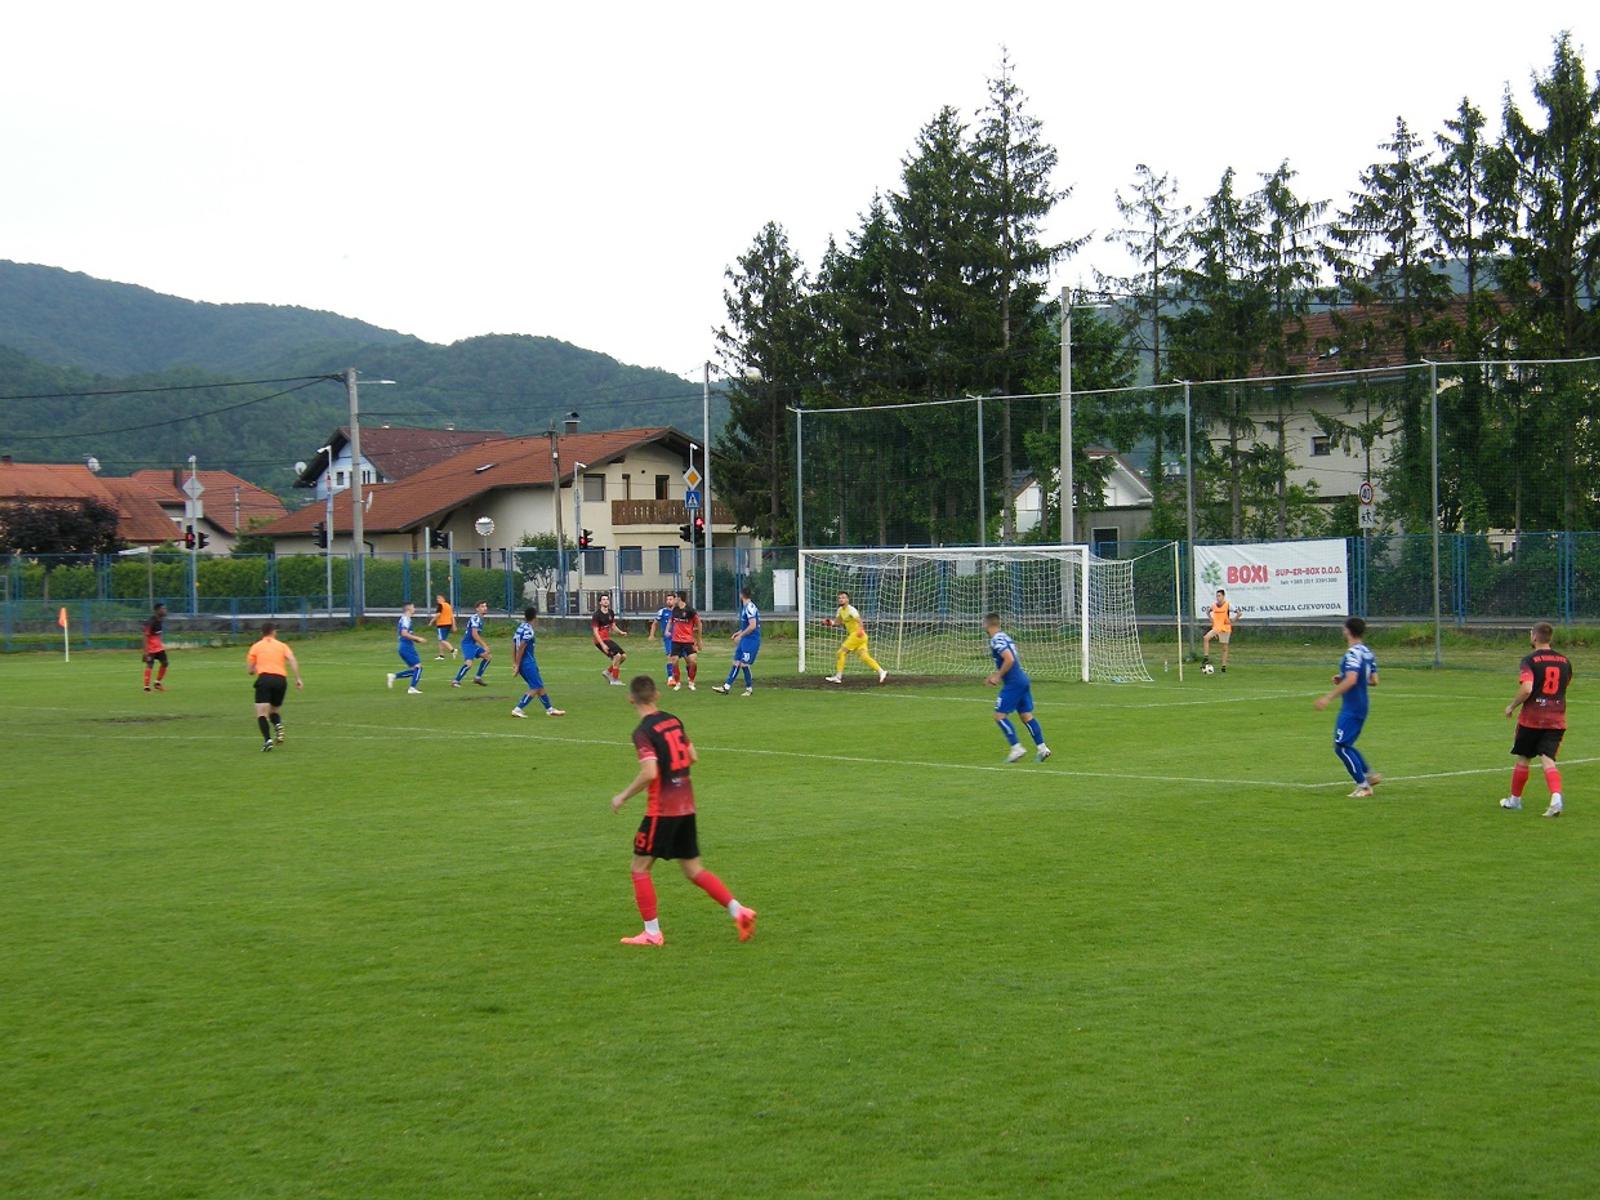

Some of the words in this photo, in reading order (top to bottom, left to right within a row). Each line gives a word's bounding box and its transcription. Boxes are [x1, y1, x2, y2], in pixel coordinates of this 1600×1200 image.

[1227, 565, 1268, 583] BOXI
[1275, 567, 1319, 576] SUP-ER-BOX
[1320, 566, 1342, 574] D.O.O.
[1259, 604, 1296, 612] SANACIJA
[1297, 603, 1341, 611] CJEVOVODA
[1542, 666, 1560, 694] 8
[664, 729, 689, 771] 15
